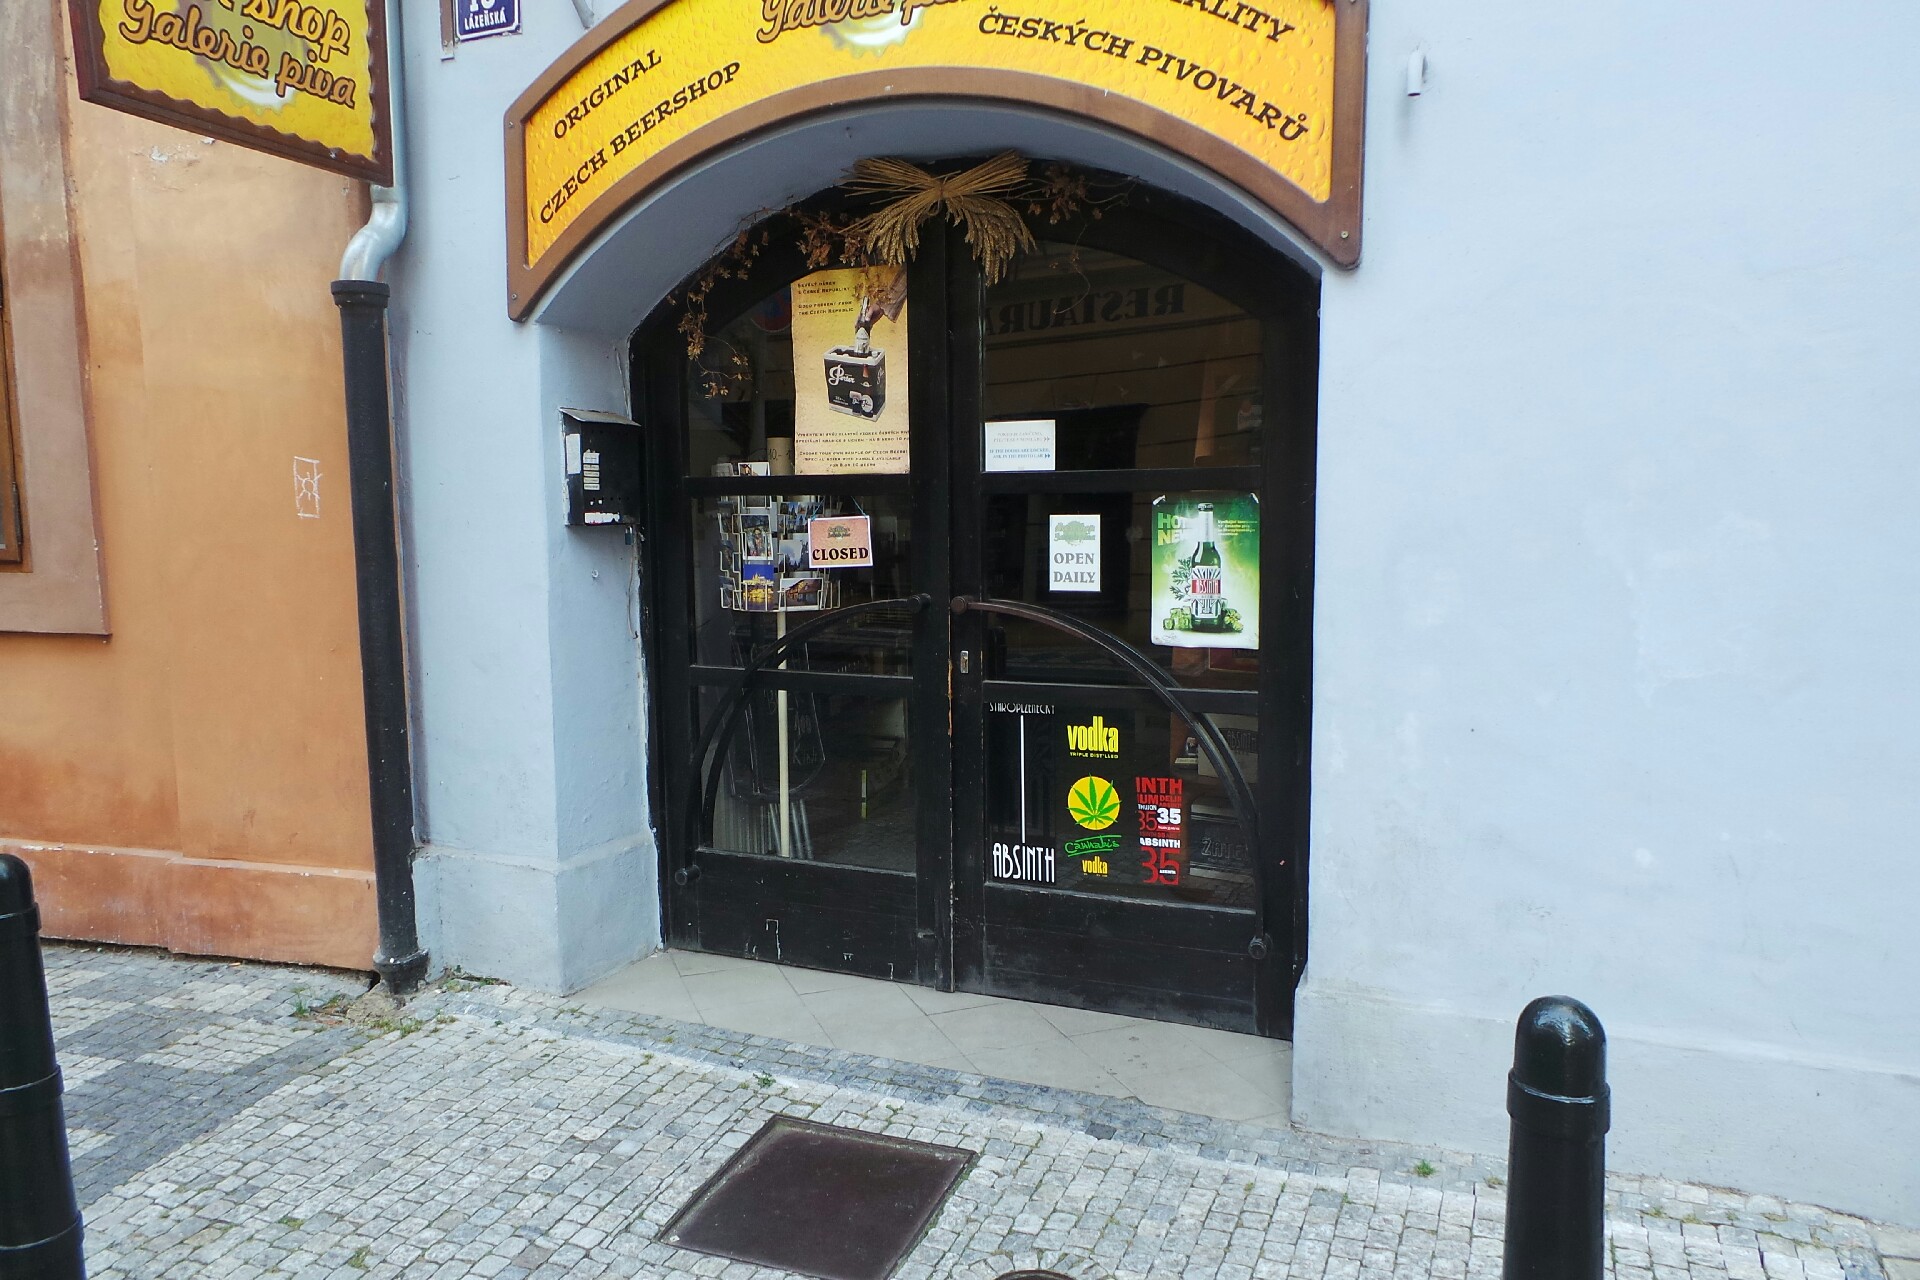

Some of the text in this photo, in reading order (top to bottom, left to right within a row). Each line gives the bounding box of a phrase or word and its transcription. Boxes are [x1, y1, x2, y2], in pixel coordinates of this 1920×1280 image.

[464, 6, 507, 31] LÁZEŇSKÁ
[275, 49, 355, 110] piva
[978, 5, 1309, 142] ČESKÝCH PIVOVARŮ
[554, 49, 662, 139] ORIGINAL
[540, 61, 741, 224] CZECH BEERSHOP
[812, 547, 869, 561] CLOSED
[1053, 552, 1095, 565] OPEN
[1053, 571, 1096, 583] DAILY
[1066, 715, 1119, 753] vodka
[1157, 807, 1182, 825] 35
[1064, 835, 1120, 854] Cannabis
[1139, 837, 1181, 850] ABSINTH
[991, 842, 1055, 883] ABSINTH
[1082, 856, 1108, 874] vodka
[1140, 847, 1181, 886] 35
